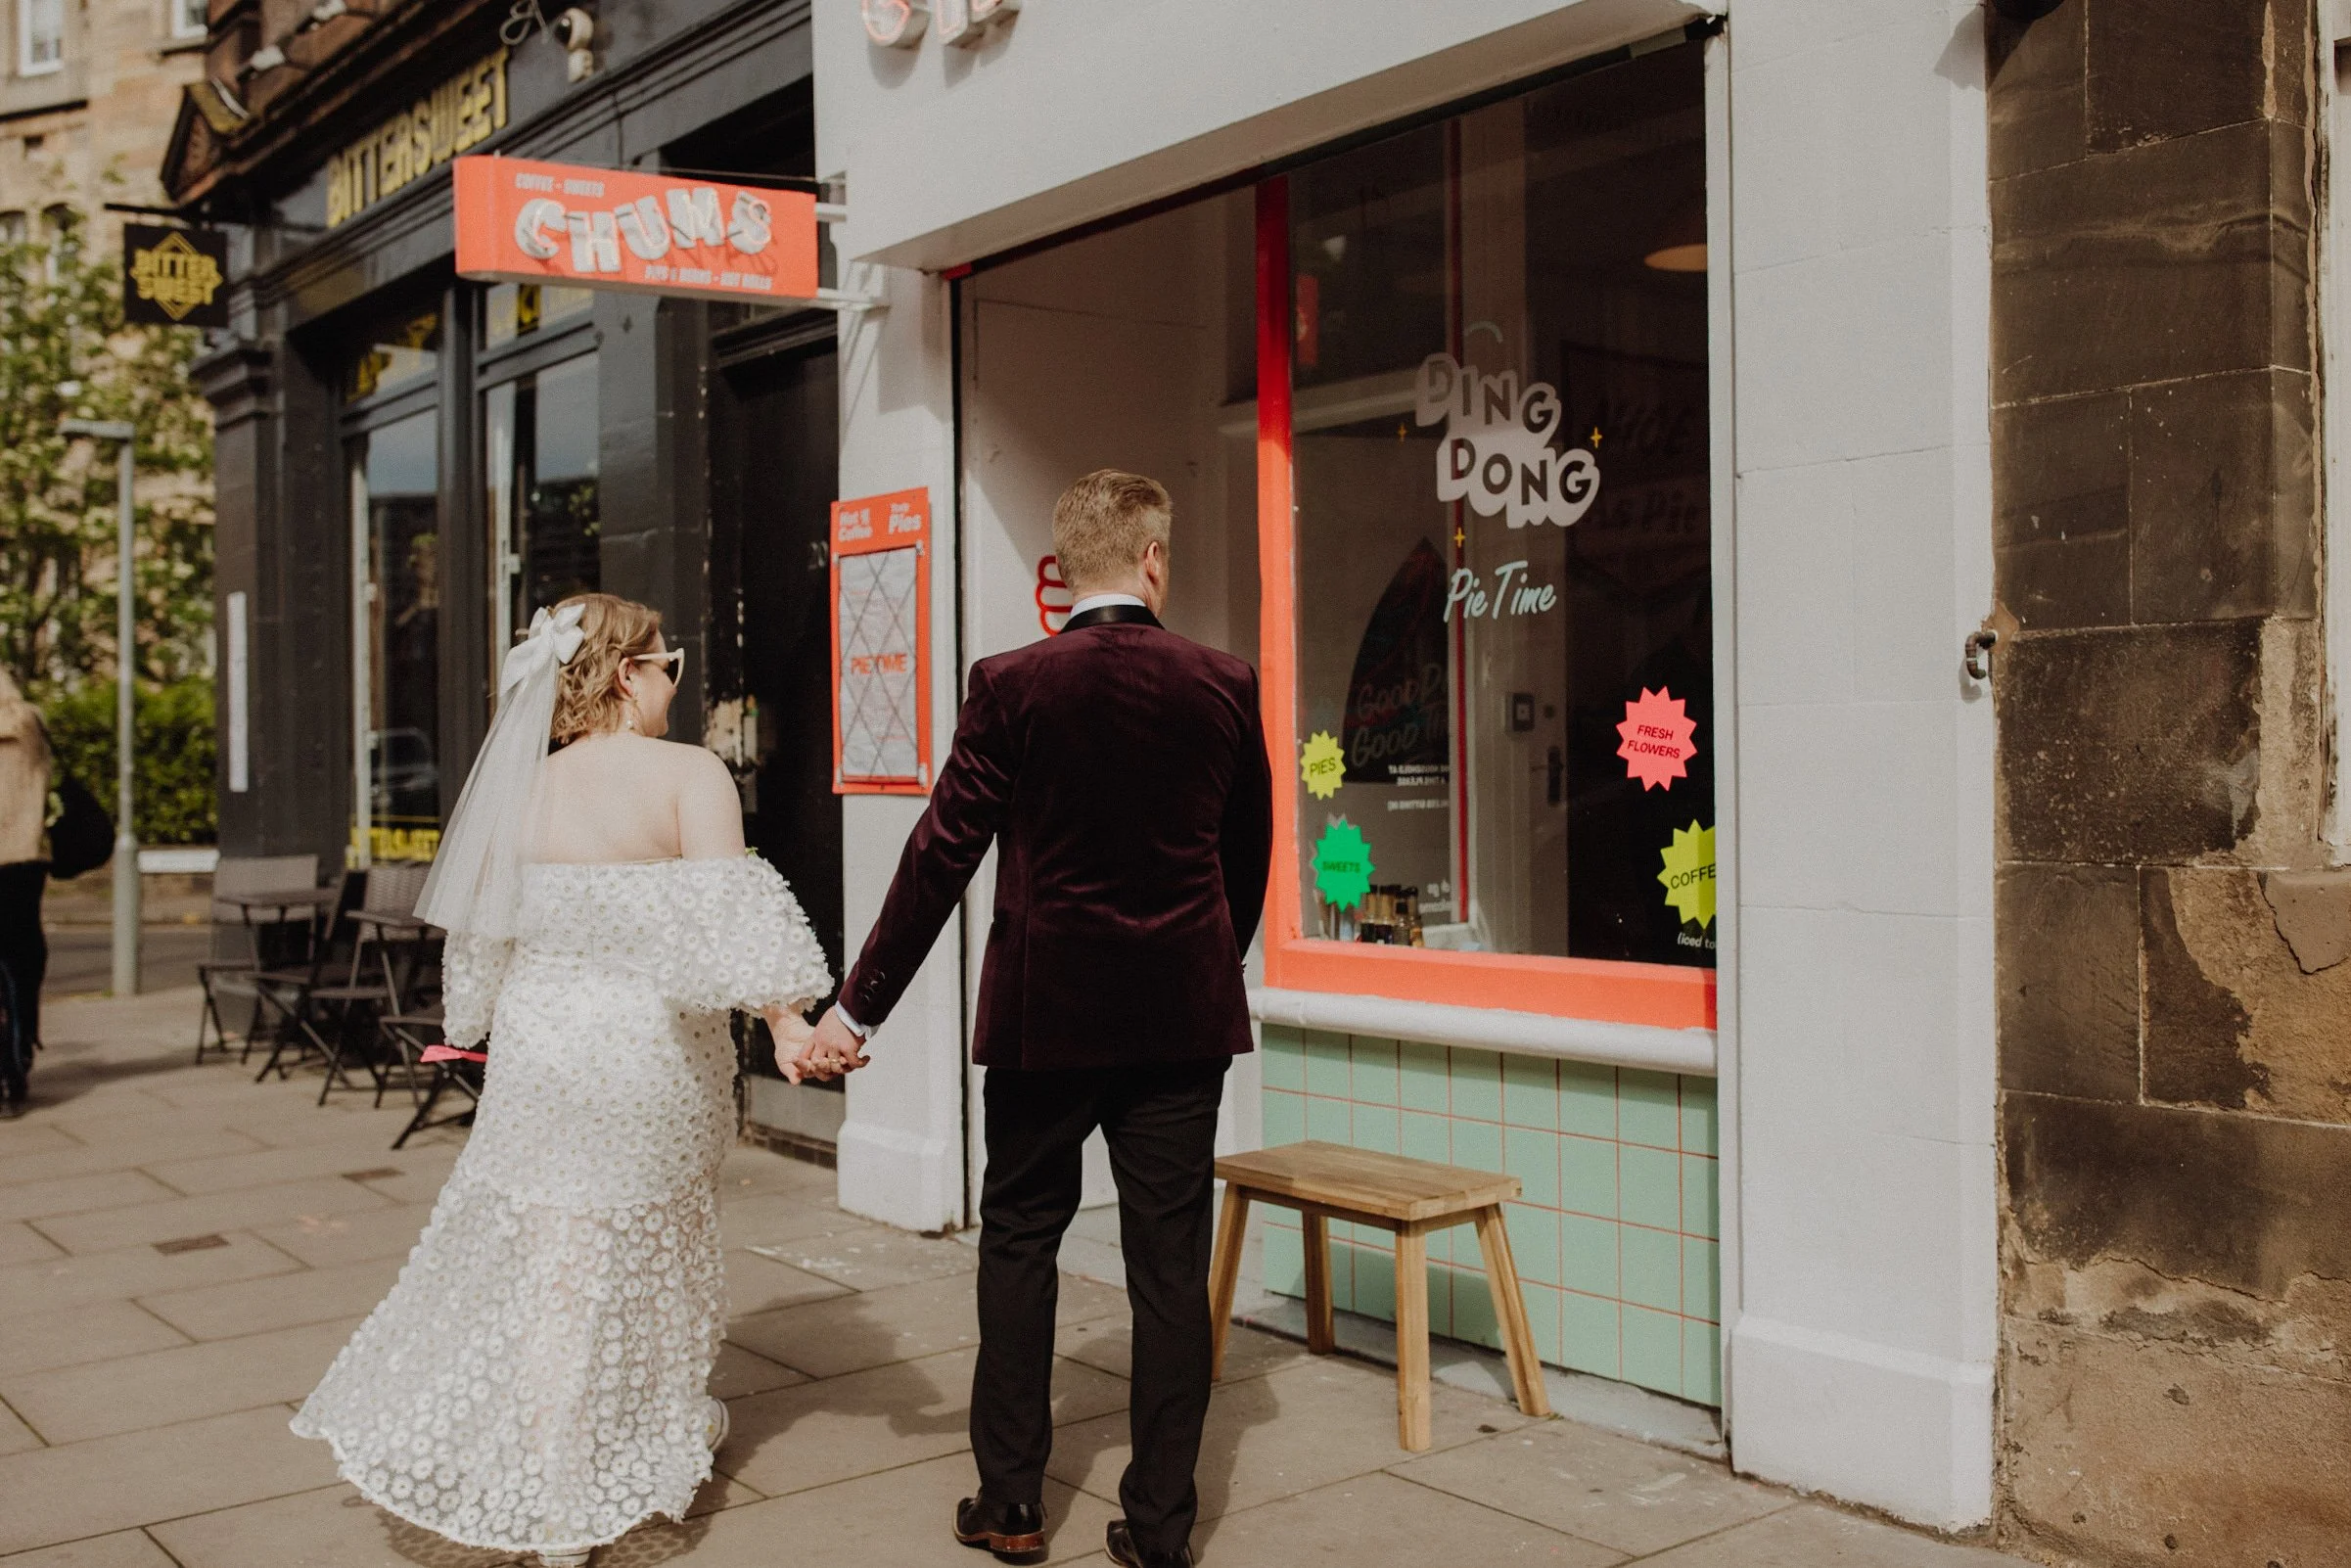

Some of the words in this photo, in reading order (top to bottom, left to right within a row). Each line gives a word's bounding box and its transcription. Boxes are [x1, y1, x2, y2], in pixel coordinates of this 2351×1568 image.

[326, 45, 509, 228] BITTERSWEET
[515, 187, 772, 273] CHUMS
[133, 249, 216, 279] BITTER
[1420, 356, 1558, 438] DING
[1443, 438, 1597, 515] DONG
[888, 514, 922, 535] Pies
[1443, 568, 1489, 623] Pie
[1492, 560, 1557, 620] Time
[851, 655, 871, 674] PIE
[1636, 724, 1674, 741] FRESH
[1627, 740, 1682, 760] FLOWERS
[1310, 757, 1337, 777] PIES
[1322, 860, 1360, 874] SWEETS
